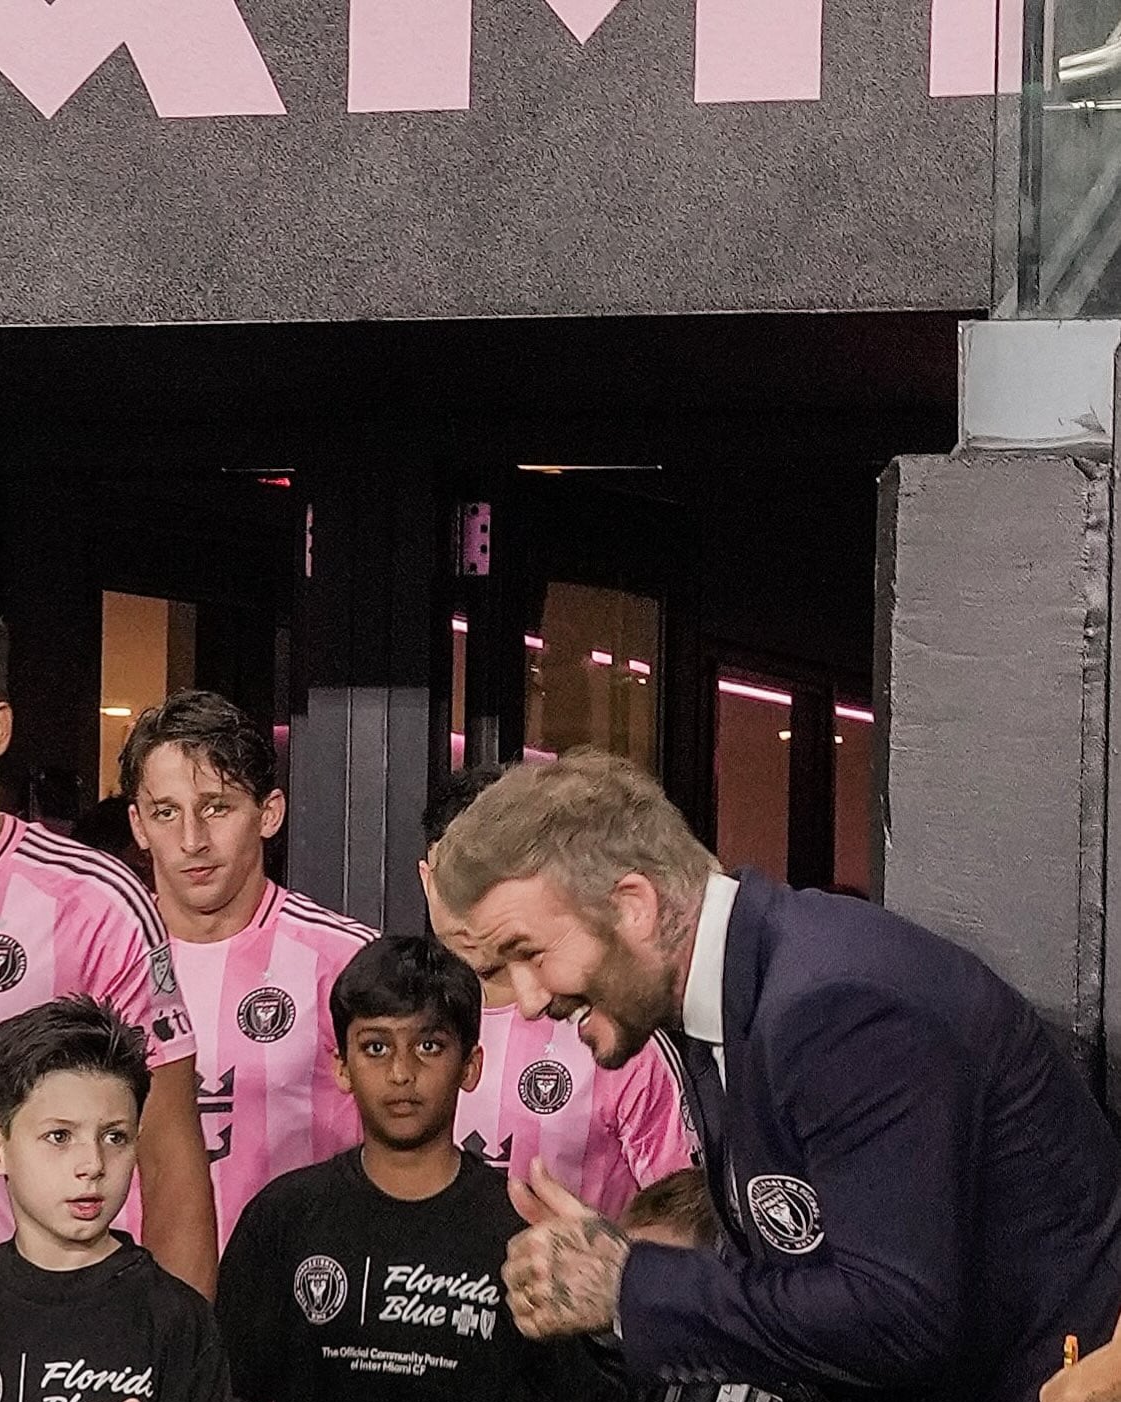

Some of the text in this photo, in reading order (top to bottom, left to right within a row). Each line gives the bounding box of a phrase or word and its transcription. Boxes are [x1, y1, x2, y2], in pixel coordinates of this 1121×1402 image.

[383, 1263, 501, 1306] Florida
[378, 1293, 447, 1327] Blue
[321, 1346, 458, 1370] The Official Community Partner
[359, 1359, 382, 1372] Inter
[382, 1360, 412, 1375] Miami
